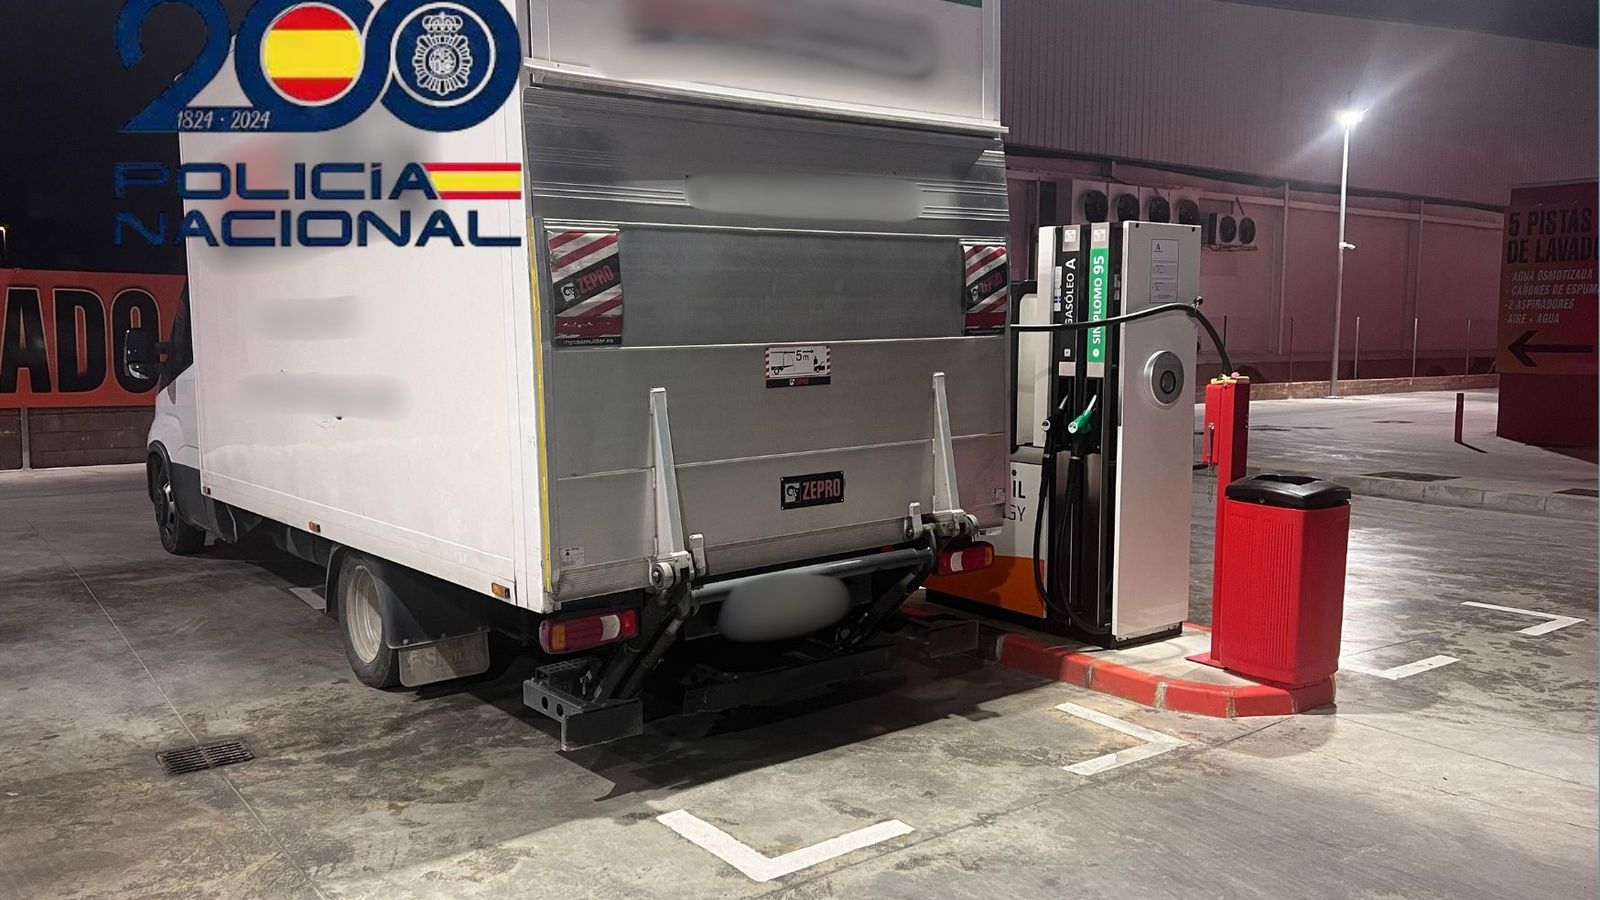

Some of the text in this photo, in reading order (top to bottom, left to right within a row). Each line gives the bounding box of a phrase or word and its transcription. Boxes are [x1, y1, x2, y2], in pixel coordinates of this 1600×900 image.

[1509, 208, 1592, 237] 5 PISTAS
[1507, 240, 1529, 264] DE
[1065, 258, 1076, 269] A
[1093, 256, 1104, 274] 95
[577, 265, 614, 294] ZEPRO
[1566, 283, 1599, 294] ESPUM
[1515, 299, 1575, 310] ASPIRADORES
[1535, 313, 1560, 325] AGUA
[802, 478, 840, 501] ZEPRO
